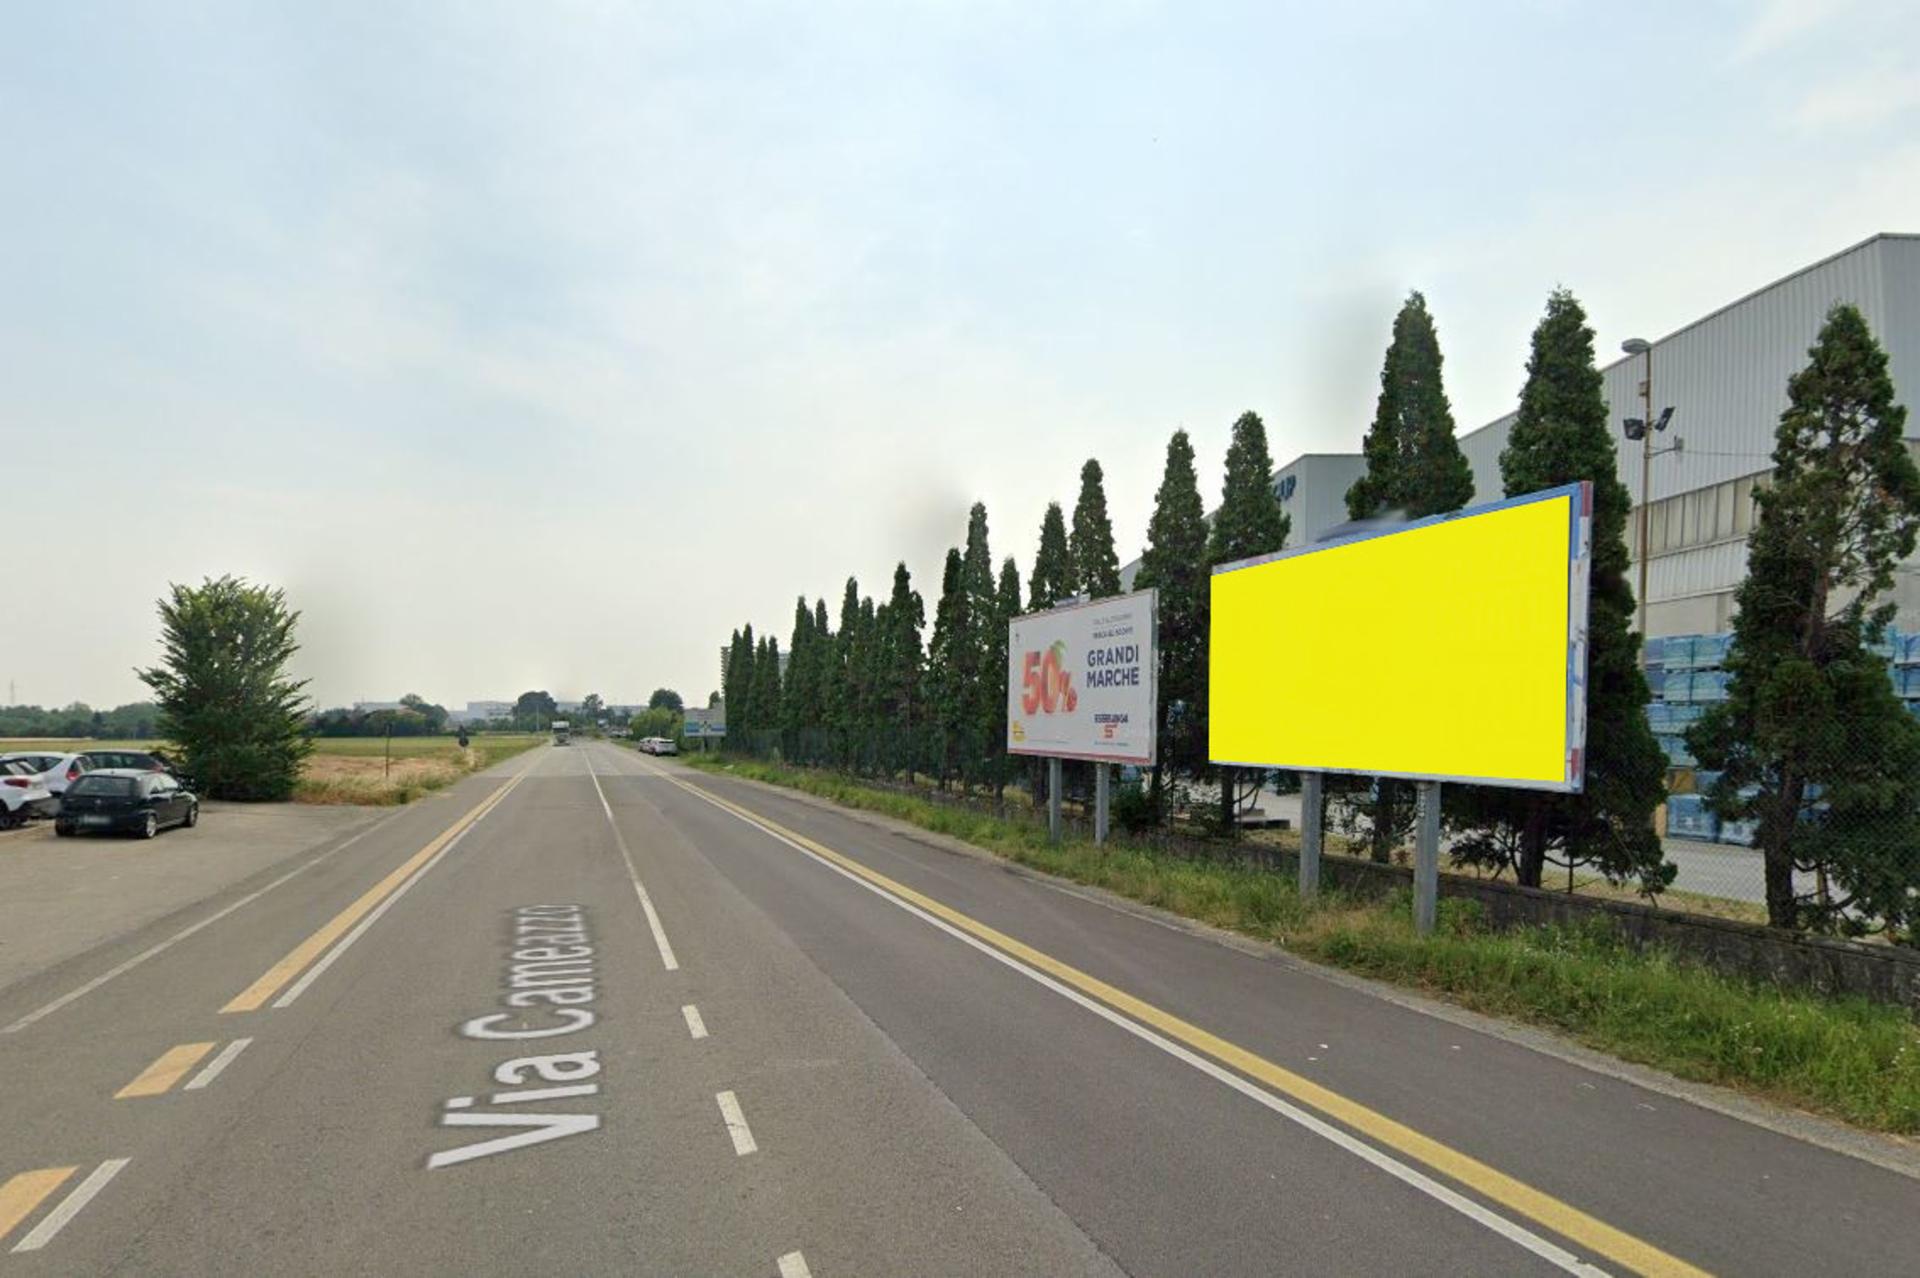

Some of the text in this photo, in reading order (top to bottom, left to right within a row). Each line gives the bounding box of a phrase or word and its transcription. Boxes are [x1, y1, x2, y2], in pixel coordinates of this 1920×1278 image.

[1087, 645, 1139, 667] GRANDI
[1022, 649, 1078, 716] 50%
[1086, 667, 1139, 688] MARCHE
